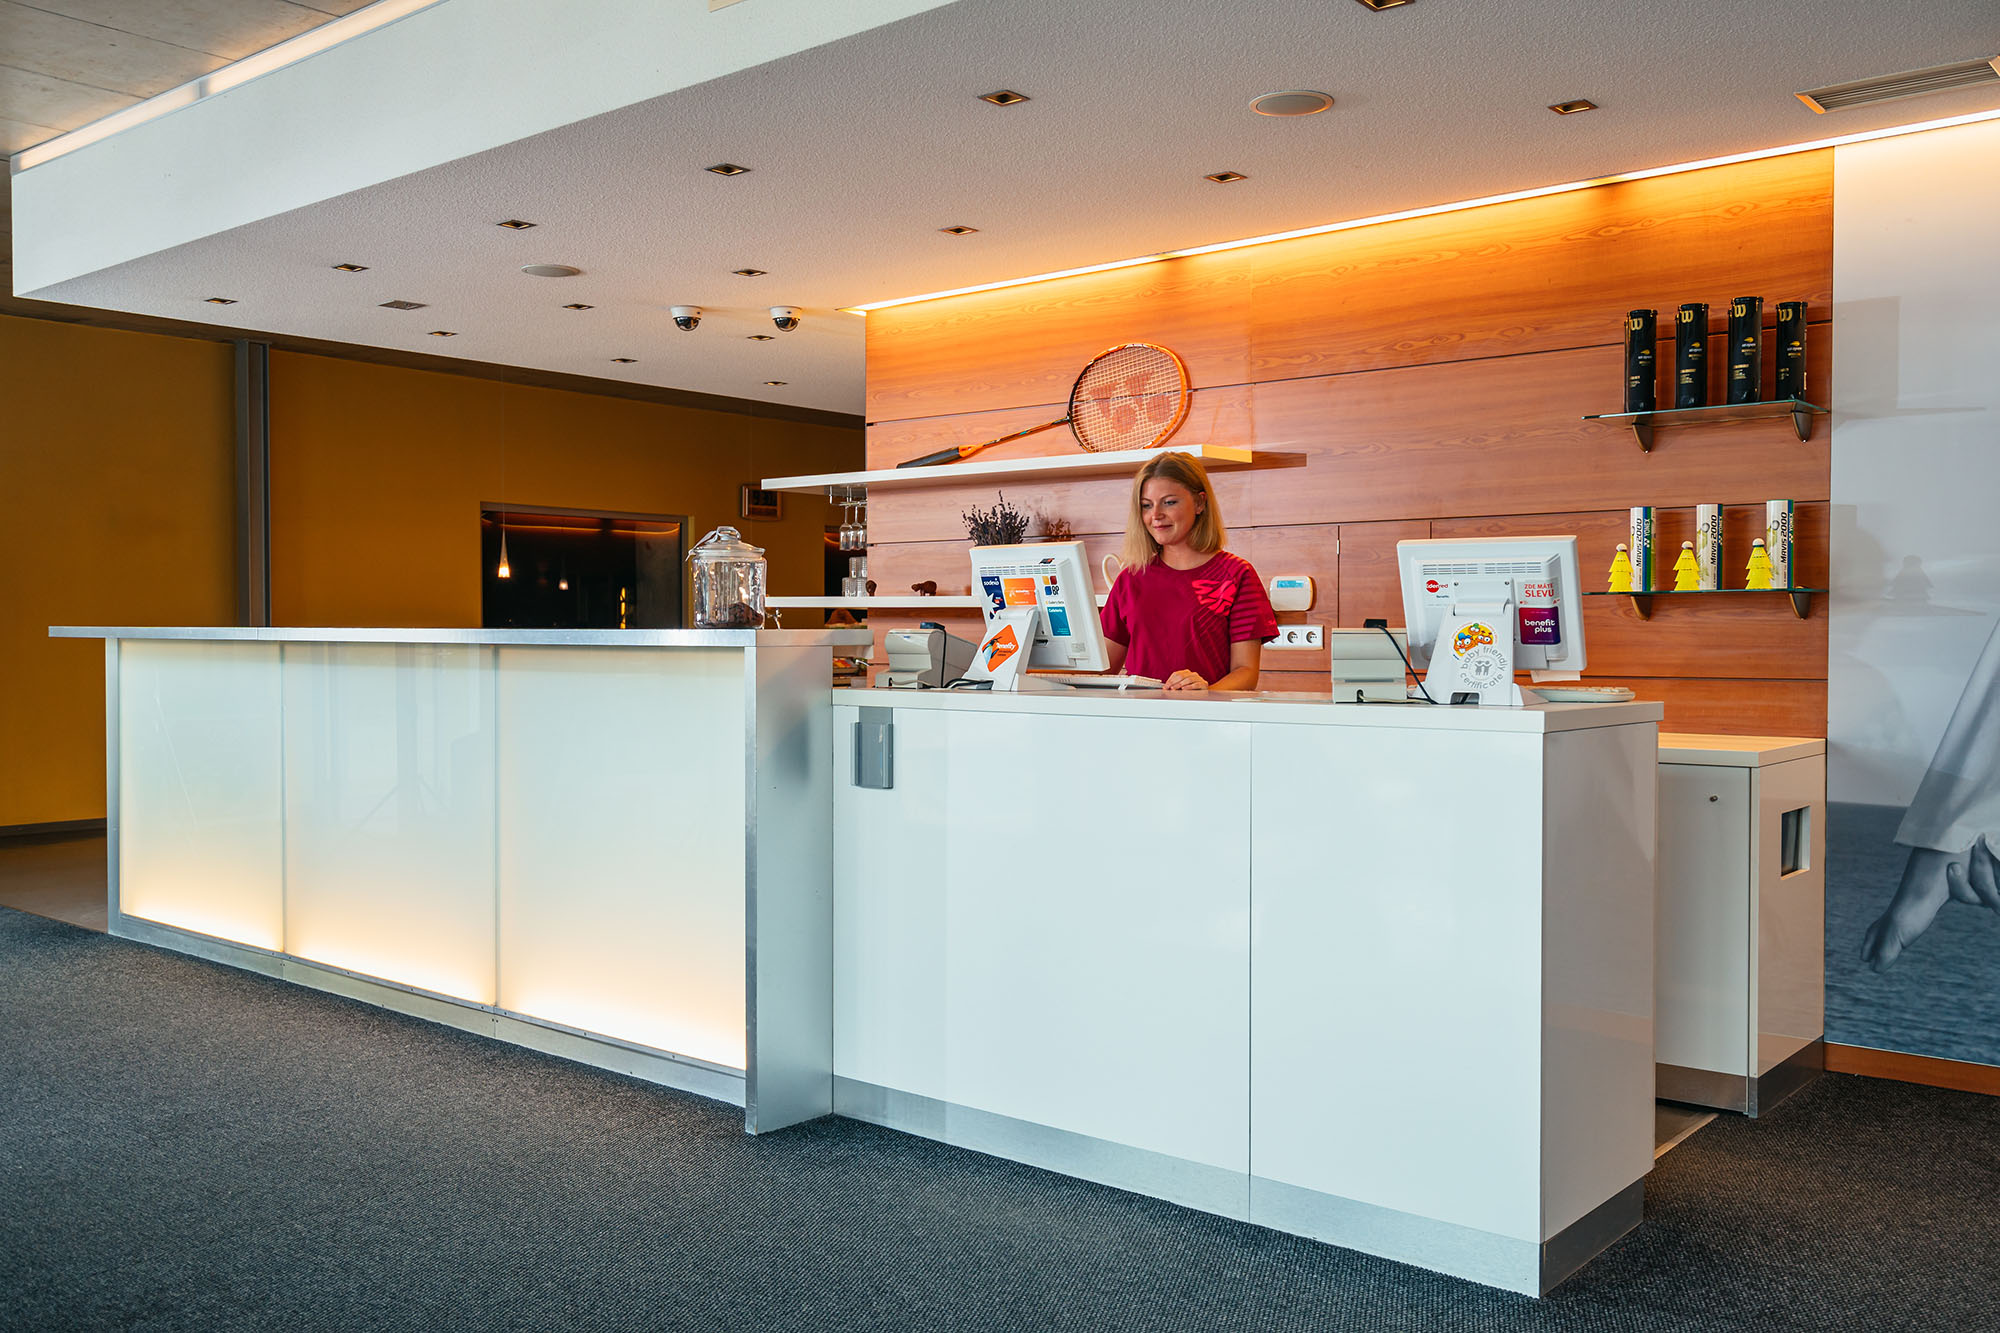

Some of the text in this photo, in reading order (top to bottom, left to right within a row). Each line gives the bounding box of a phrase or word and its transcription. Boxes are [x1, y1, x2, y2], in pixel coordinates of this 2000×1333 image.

[1525, 589, 1555, 598] SLEVU
[1524, 618, 1556, 626] benefit
[1534, 625, 1552, 634] plus
[1460, 645, 1508, 671] baby friendly
[1460, 672, 1504, 689] certificate
